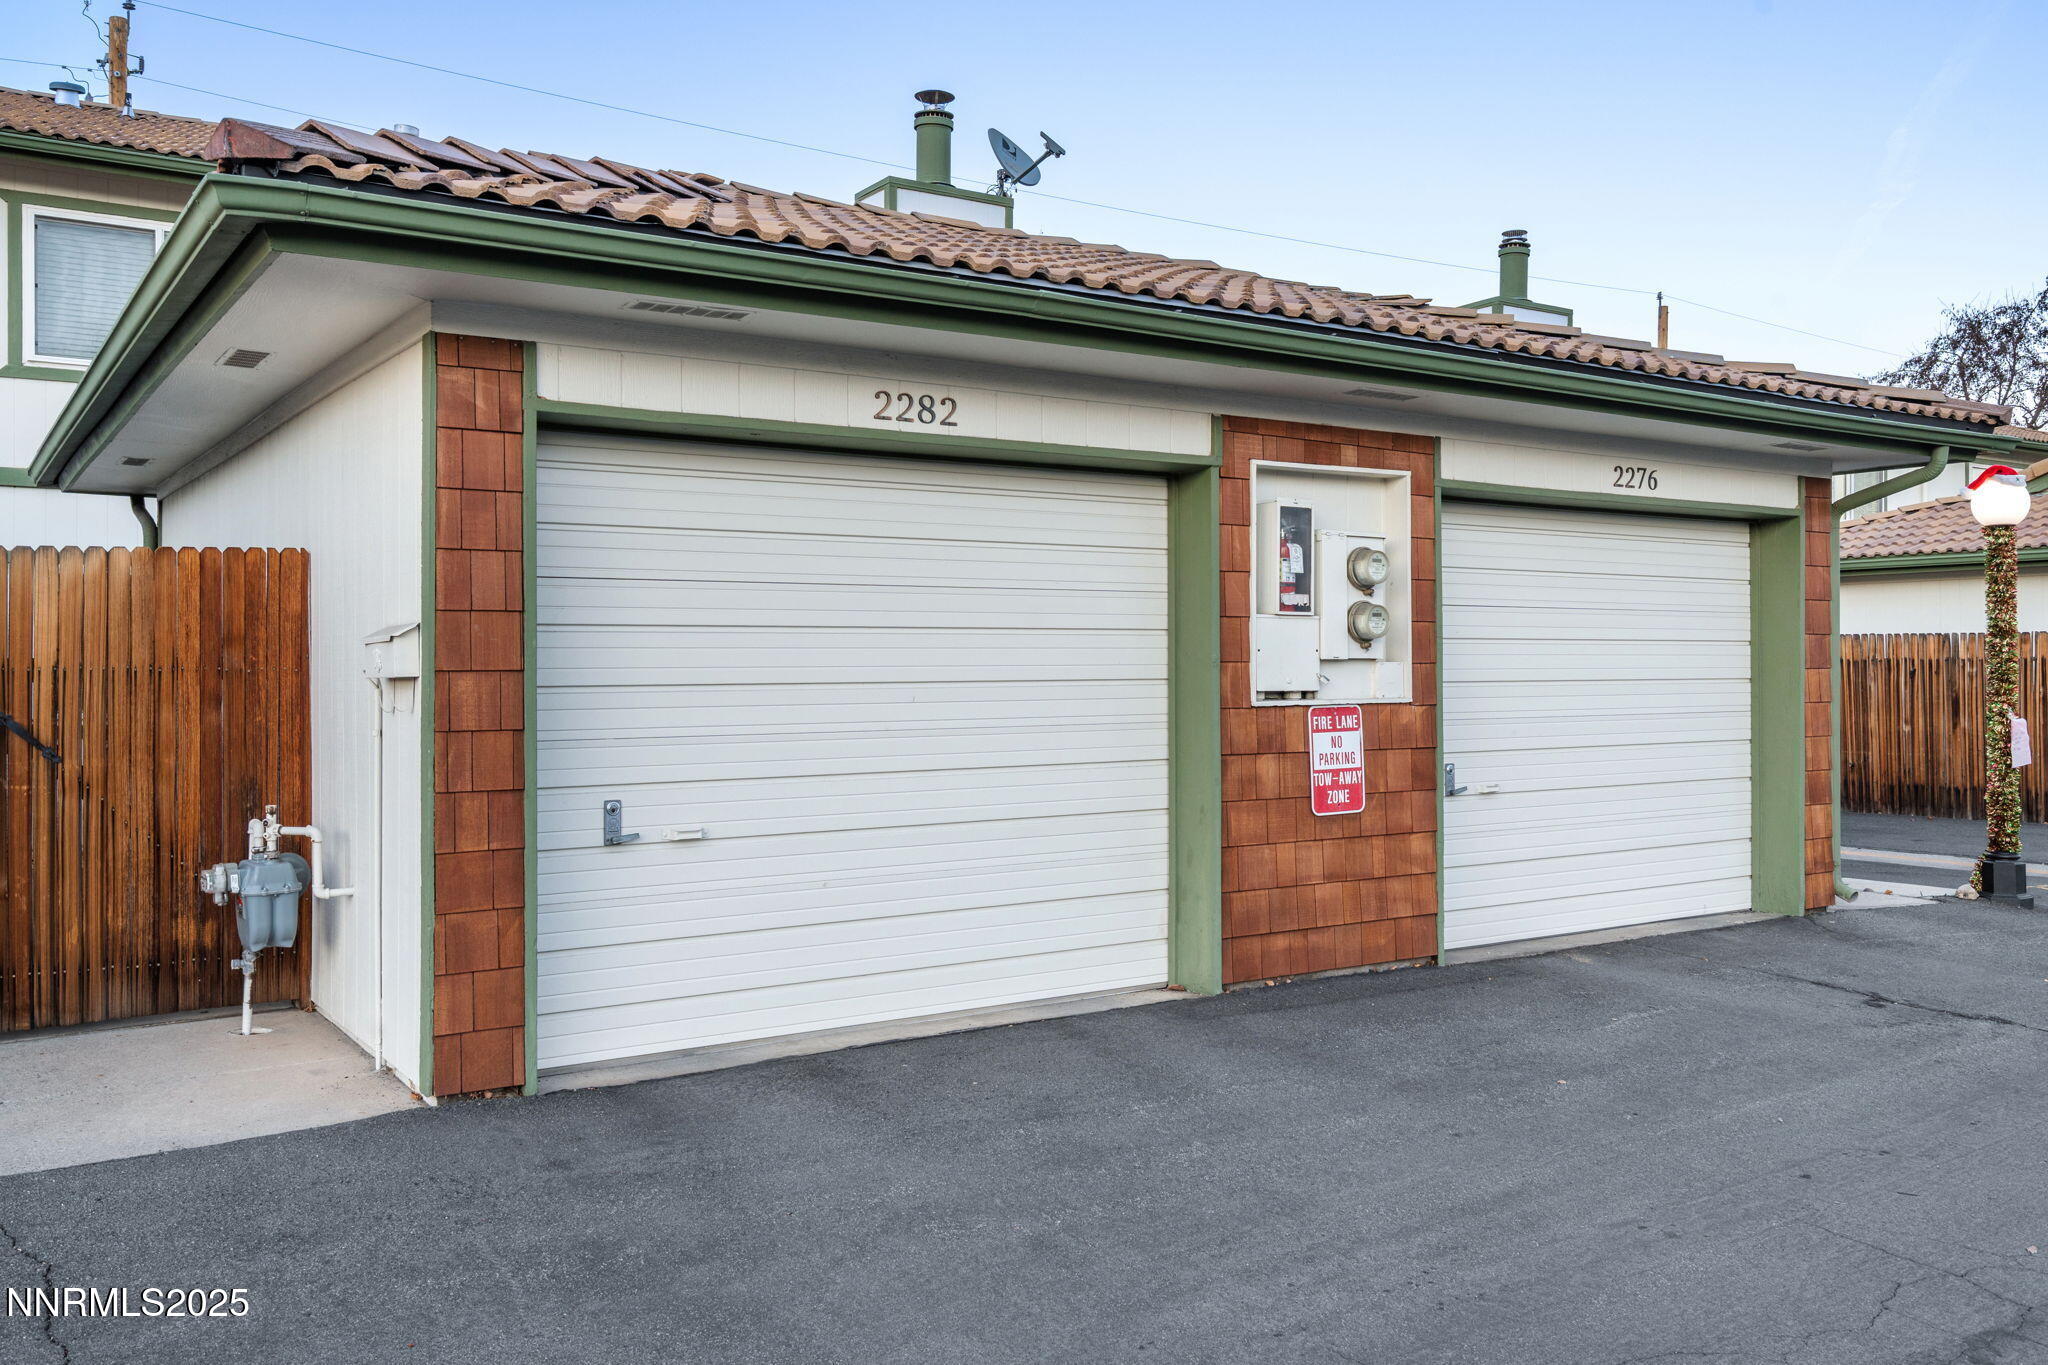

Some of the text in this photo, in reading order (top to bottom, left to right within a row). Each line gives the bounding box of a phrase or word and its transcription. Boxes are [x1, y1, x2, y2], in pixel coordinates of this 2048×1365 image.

[874, 390, 958, 427] 2282
[1613, 465, 1658, 491] 2276
[1312, 714, 1359, 730] FIRE LANE
[1330, 735, 1343, 748] NO
[1319, 751, 1356, 766] PARKING
[1313, 770, 1362, 786] TOW-AWAY
[1327, 789, 1350, 804] ZONE
